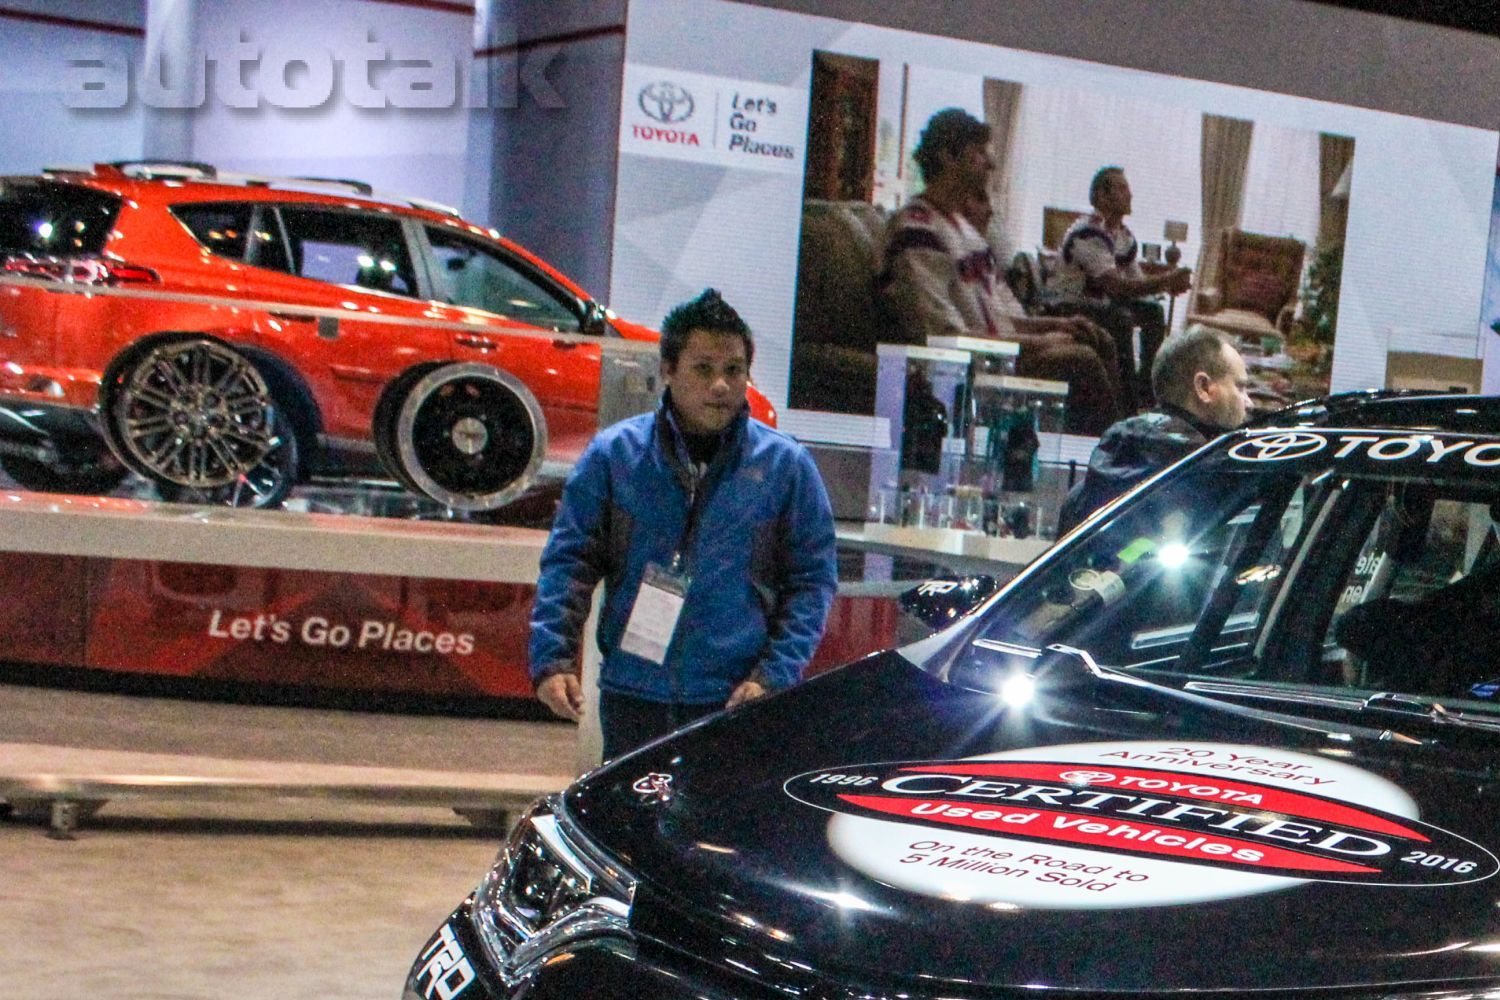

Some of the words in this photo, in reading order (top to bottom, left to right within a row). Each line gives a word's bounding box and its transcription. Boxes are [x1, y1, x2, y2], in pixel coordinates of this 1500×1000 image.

[731, 92, 778, 114] Let's
[632, 124, 700, 147] TOYOTA
[729, 113, 757, 132] Go
[727, 133, 795, 159] Places
[918, 581, 958, 596] TRD
[208, 609, 291, 642] Let's
[301, 616, 350, 646] Go
[357, 620, 475, 655] Places
[1098, 751, 1336, 786] Anniversary
[1158, 747, 1215, 759] 20
[1228, 753, 1314, 771] Year
[1118, 776, 1264, 805] TOYOTA
[798, 773, 880, 787] 1996
[881, 774, 1392, 857] CERTIFIED
[1400, 850, 1478, 874] 2016
[910, 803, 1035, 825] Used
[1052, 815, 1265, 863] Vehicles
[899, 853, 930, 864] 5
[927, 856, 1030, 878] Million
[1035, 871, 1118, 893] Sold
[908, 840, 956, 853] On
[960, 845, 1014, 860] the
[1018, 853, 1113, 875] Road
[1113, 867, 1150, 882] to
